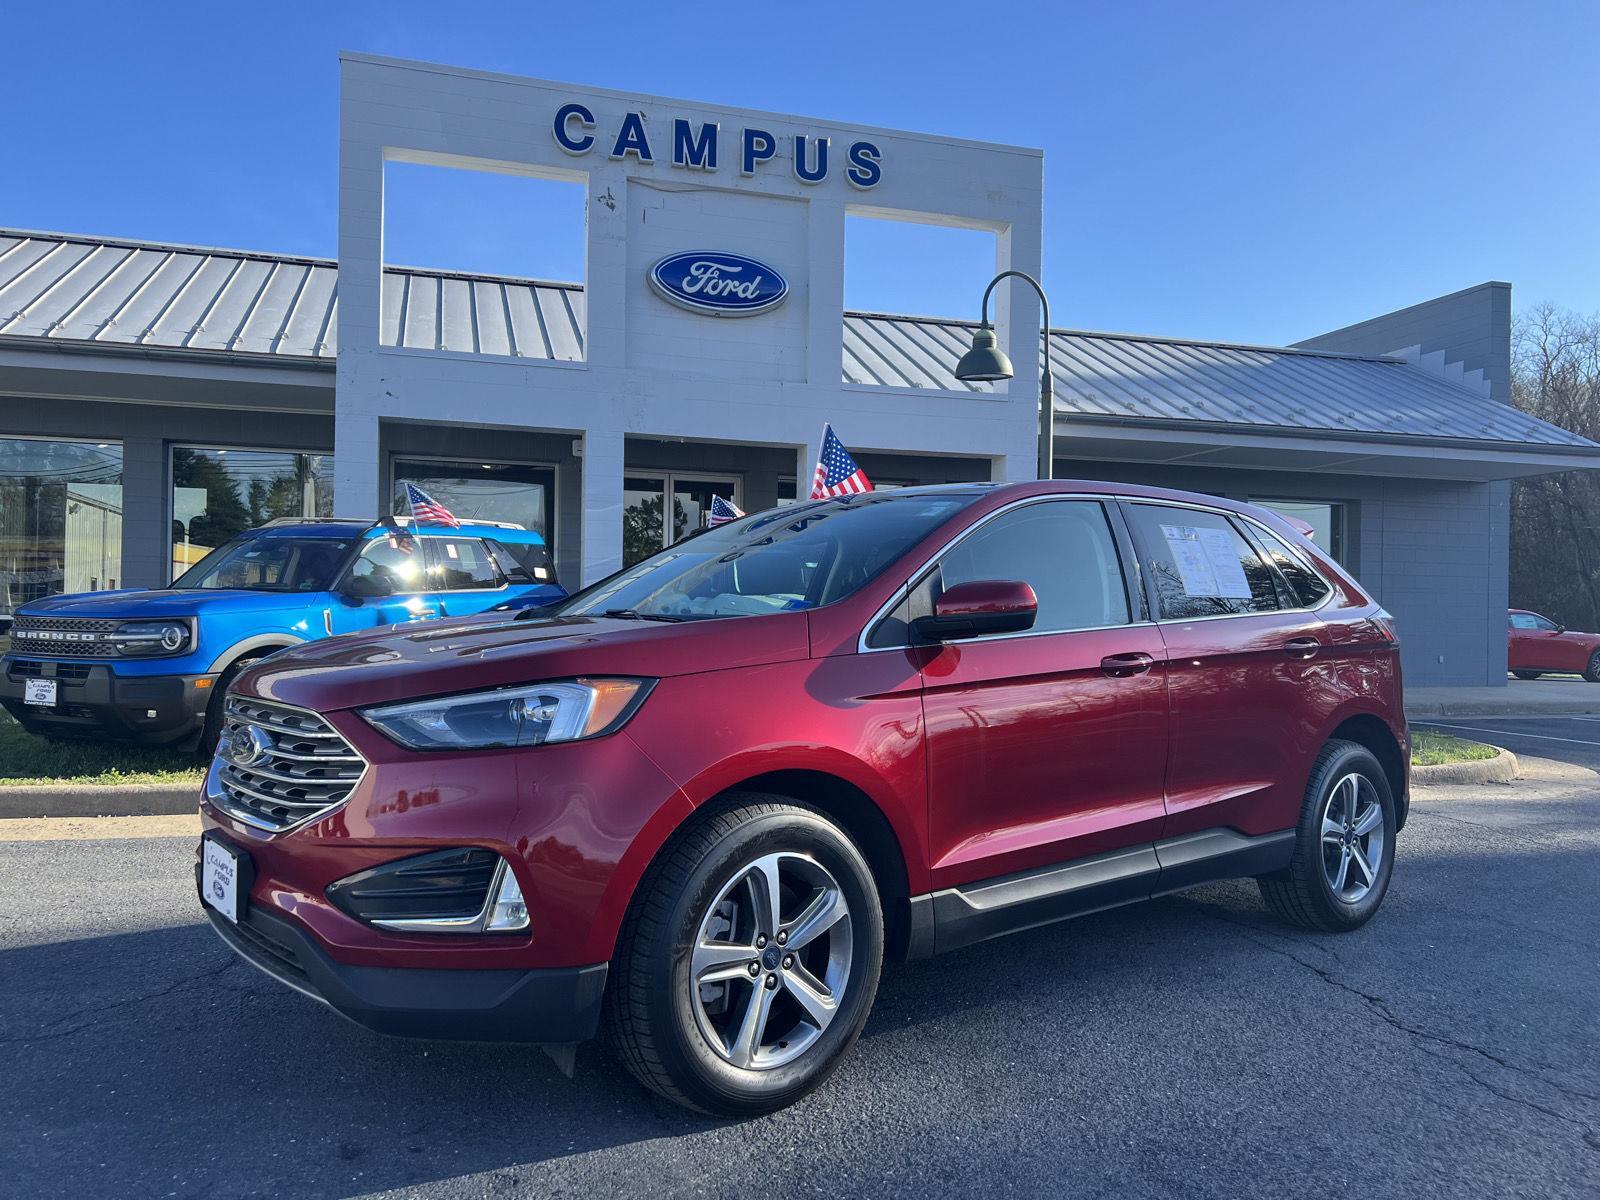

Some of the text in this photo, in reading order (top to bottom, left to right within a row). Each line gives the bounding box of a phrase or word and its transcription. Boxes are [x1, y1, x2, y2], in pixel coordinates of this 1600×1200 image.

[552, 102, 883, 191] CAMPUS
[681, 261, 761, 299] Ford
[17, 631, 95, 640] BRONCO
